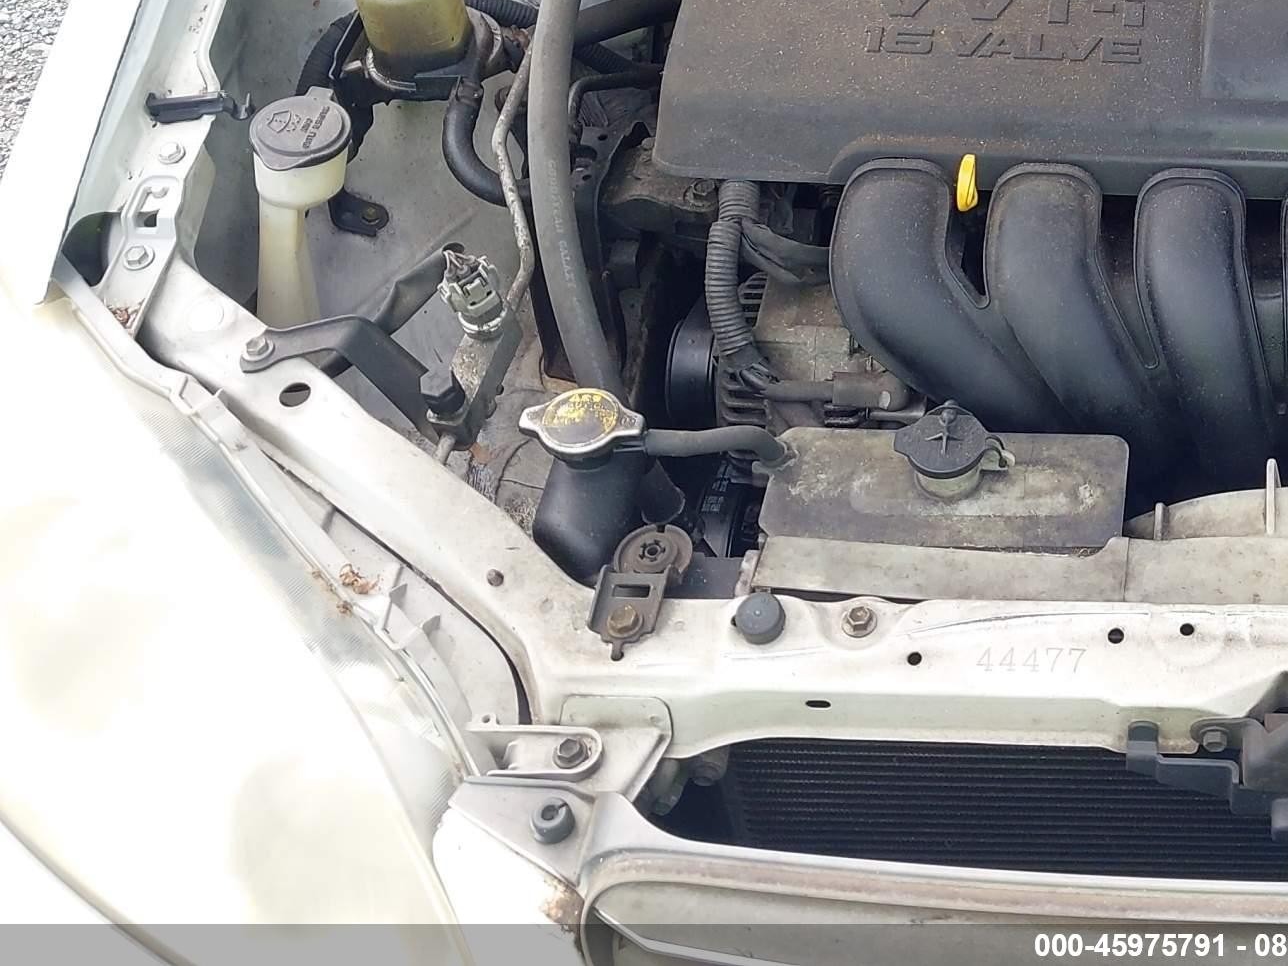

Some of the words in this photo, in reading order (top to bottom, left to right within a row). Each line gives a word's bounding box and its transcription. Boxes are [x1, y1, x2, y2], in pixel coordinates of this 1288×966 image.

[864, 27, 935, 54] 16
[953, 31, 1142, 64] VALVE
[975, 646, 1087, 674] 44477
